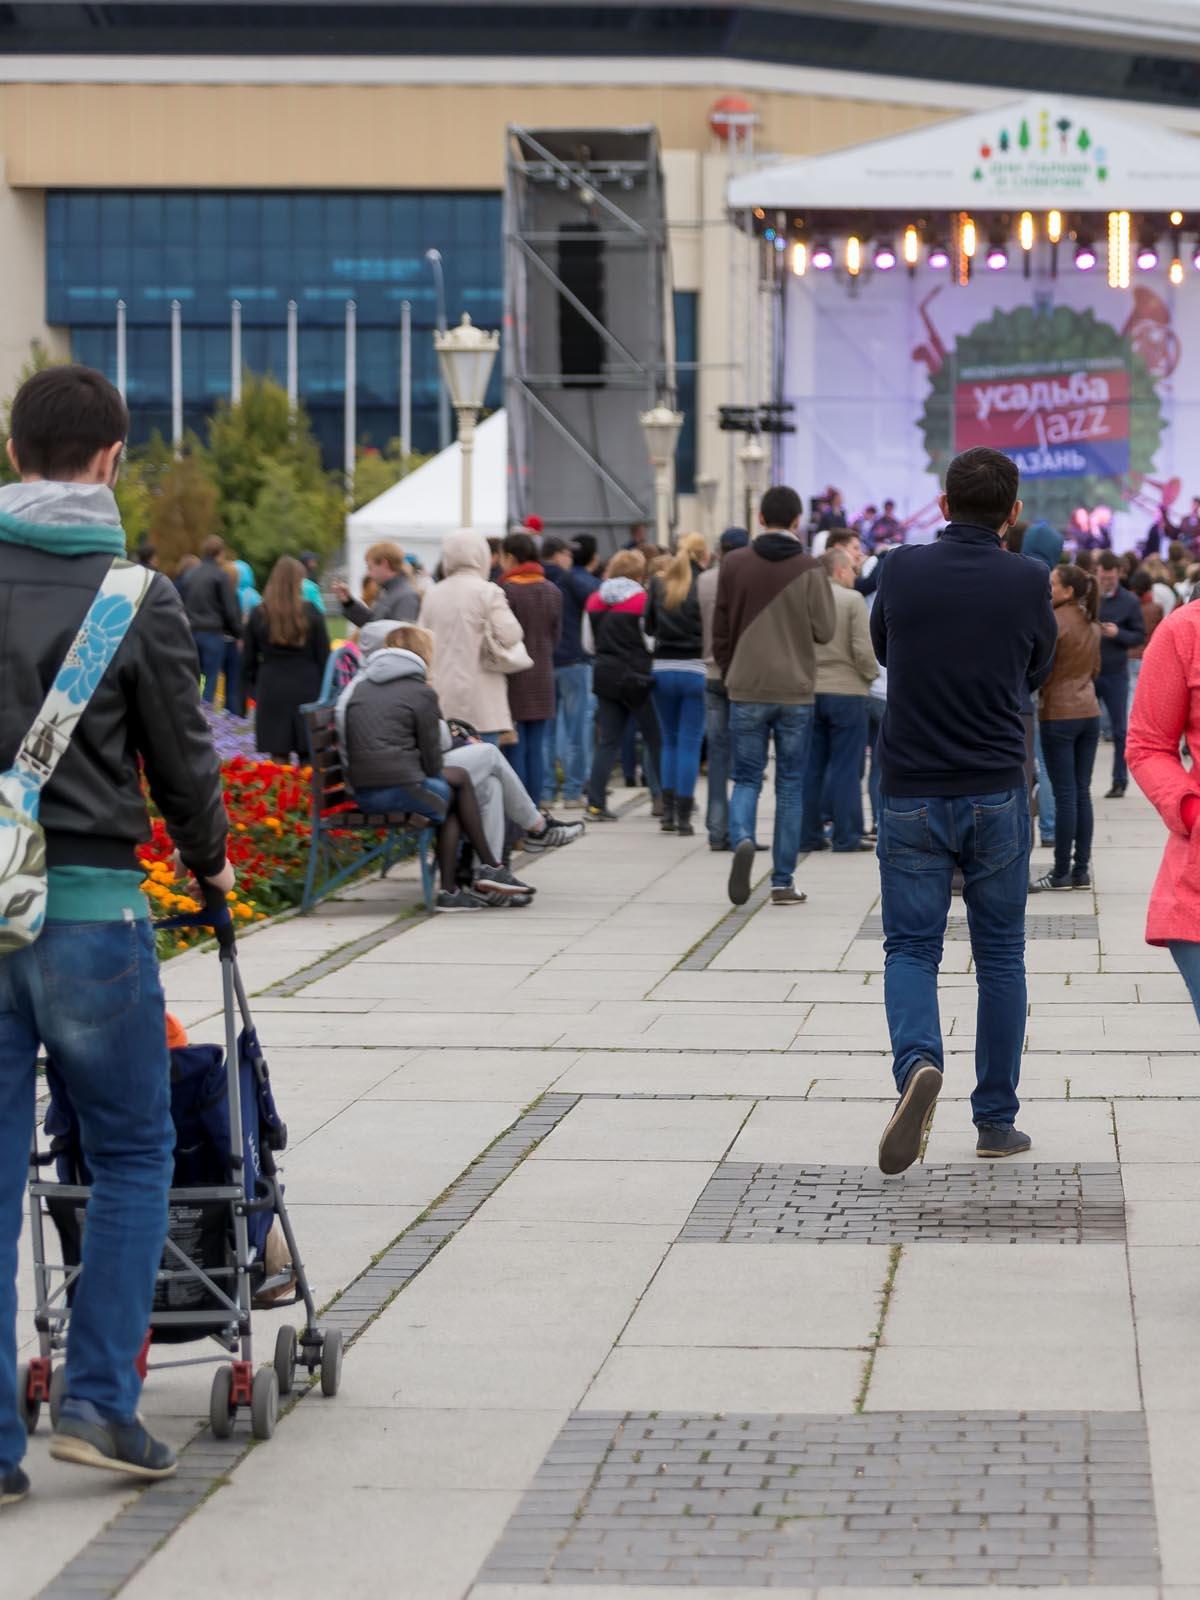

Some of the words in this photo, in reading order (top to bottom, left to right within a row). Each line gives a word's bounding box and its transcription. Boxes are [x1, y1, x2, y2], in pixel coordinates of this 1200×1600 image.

[973, 371, 1109, 431] усадьба
[1034, 405, 1110, 455] jazz
[1010, 449, 1087, 474] АЗАНЬ
